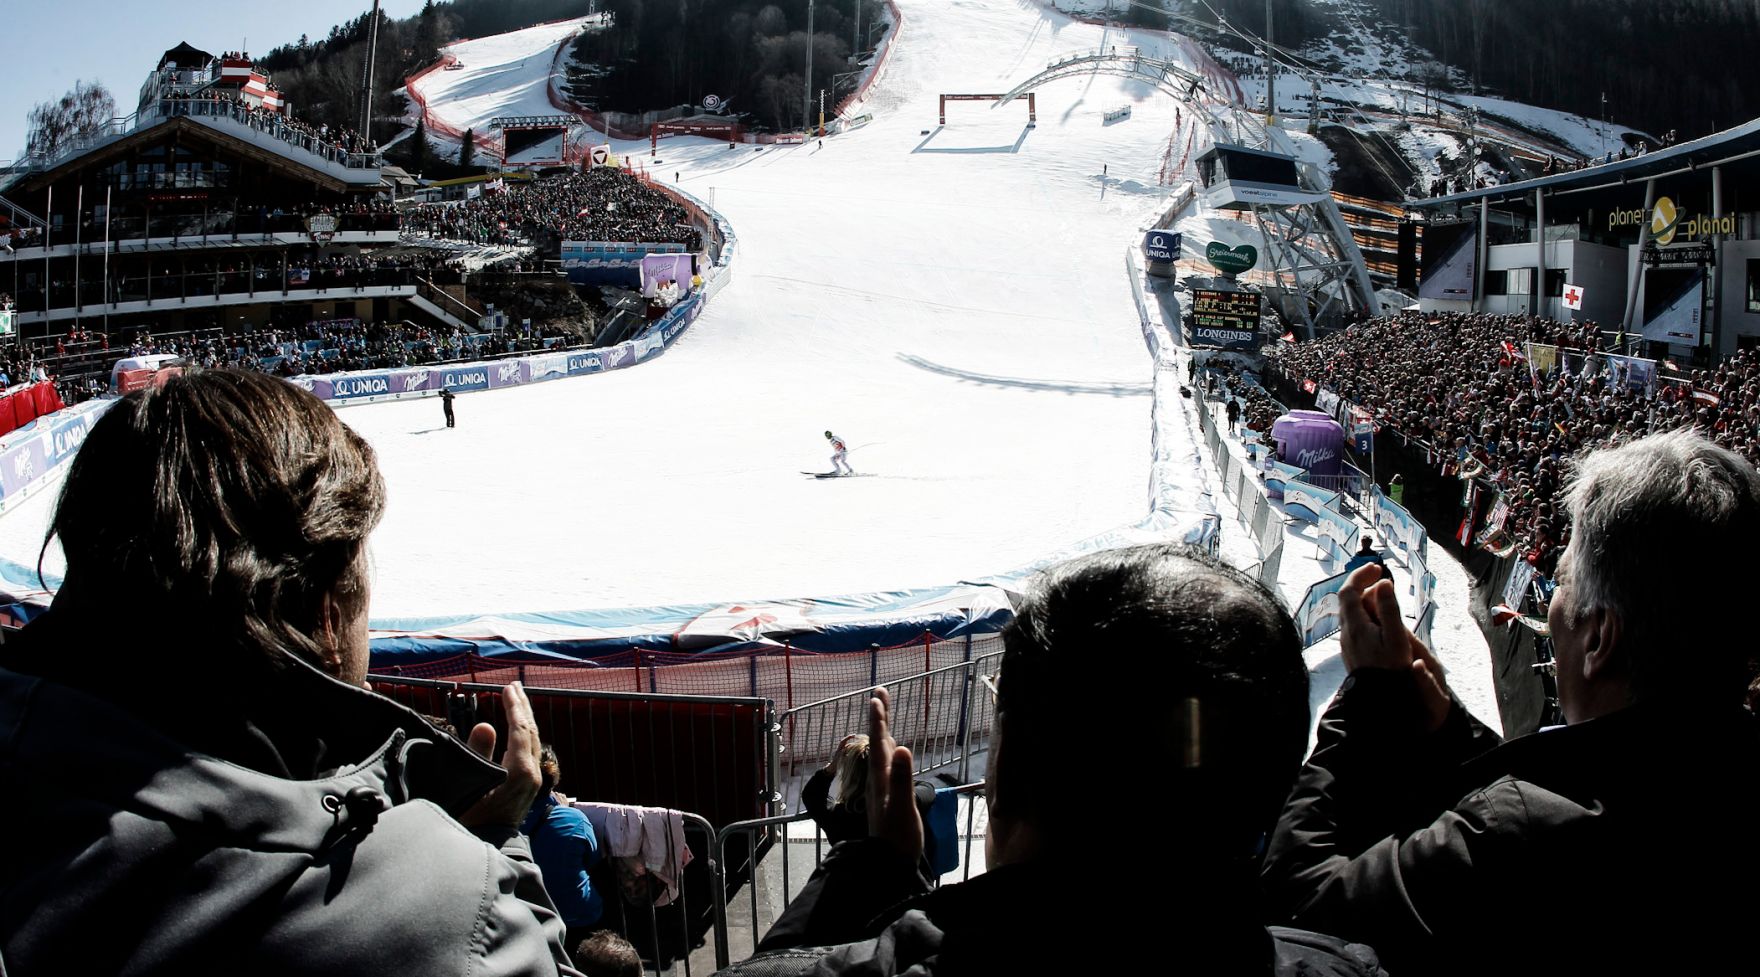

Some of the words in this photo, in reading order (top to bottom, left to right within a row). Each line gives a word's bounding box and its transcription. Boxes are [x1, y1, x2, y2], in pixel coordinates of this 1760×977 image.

[1608, 206, 1646, 231] planet
[1687, 211, 1735, 241] planai
[1145, 248, 1170, 259] UNIQA
[1208, 247, 1251, 264] Steiermark
[1196, 327, 1252, 341] LONGINES
[579, 356, 602, 368] UNIQA
[352, 379, 388, 394] UNIQA
[458, 373, 487, 386] UNIQA
[1361, 440, 1369, 451] 3
[1296, 448, 1336, 469] Milka
